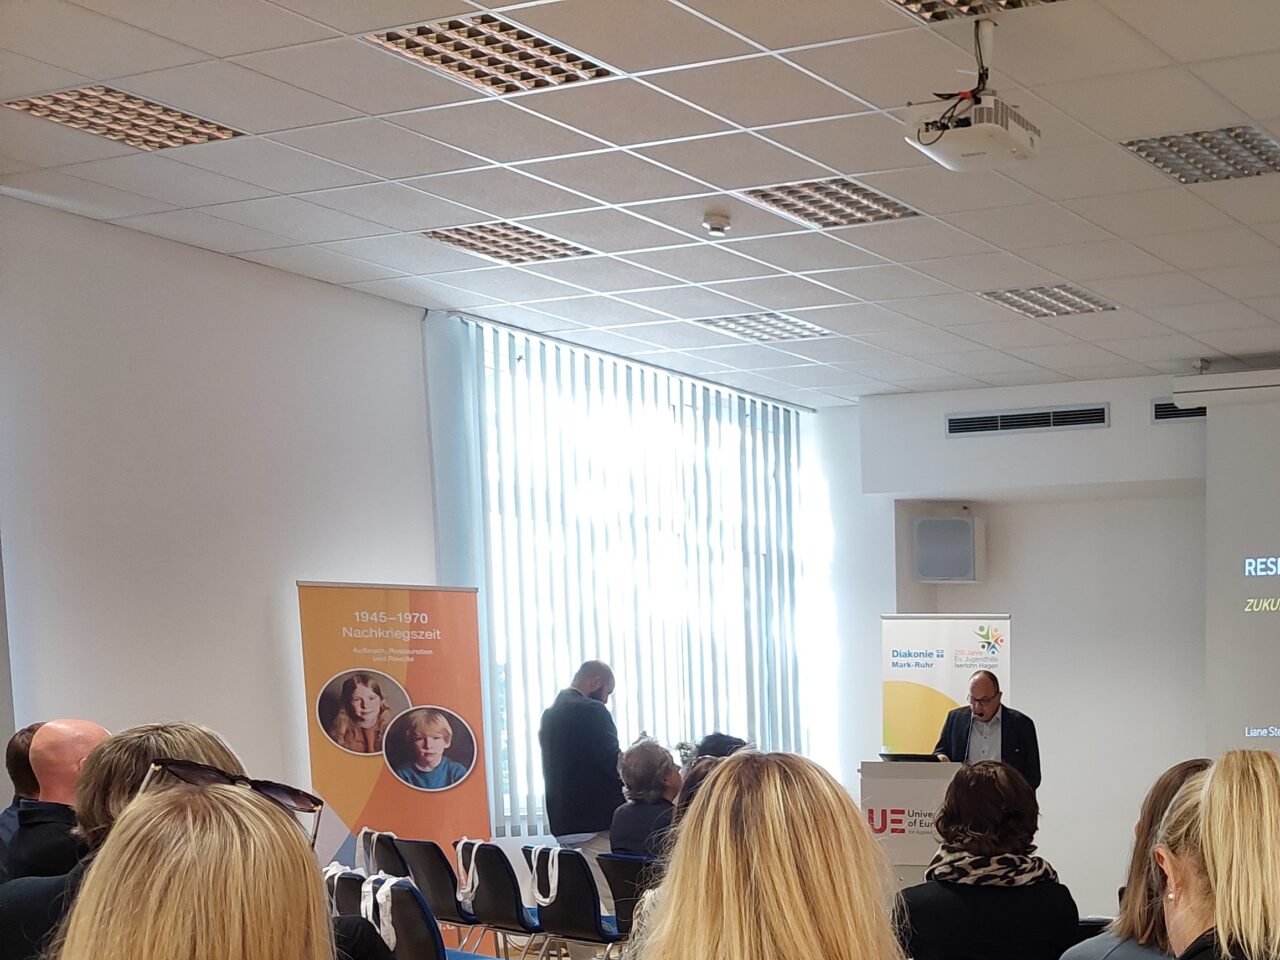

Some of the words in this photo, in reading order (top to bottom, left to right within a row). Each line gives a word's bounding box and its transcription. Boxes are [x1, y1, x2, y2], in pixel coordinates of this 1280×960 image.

[342, 626, 441, 642] Nachkriegszeit
[892, 649, 934, 658] Diakonie
[966, 656, 998, 664] Jugendhilfe
[892, 661, 934, 669] Mark-Ruhr
[979, 663, 999, 671] Hagen
[1245, 727, 1268, 737] Liane
[908, 810, 934, 818] Unive
[868, 809, 906, 834] UE
[908, 819, 917, 827] of
